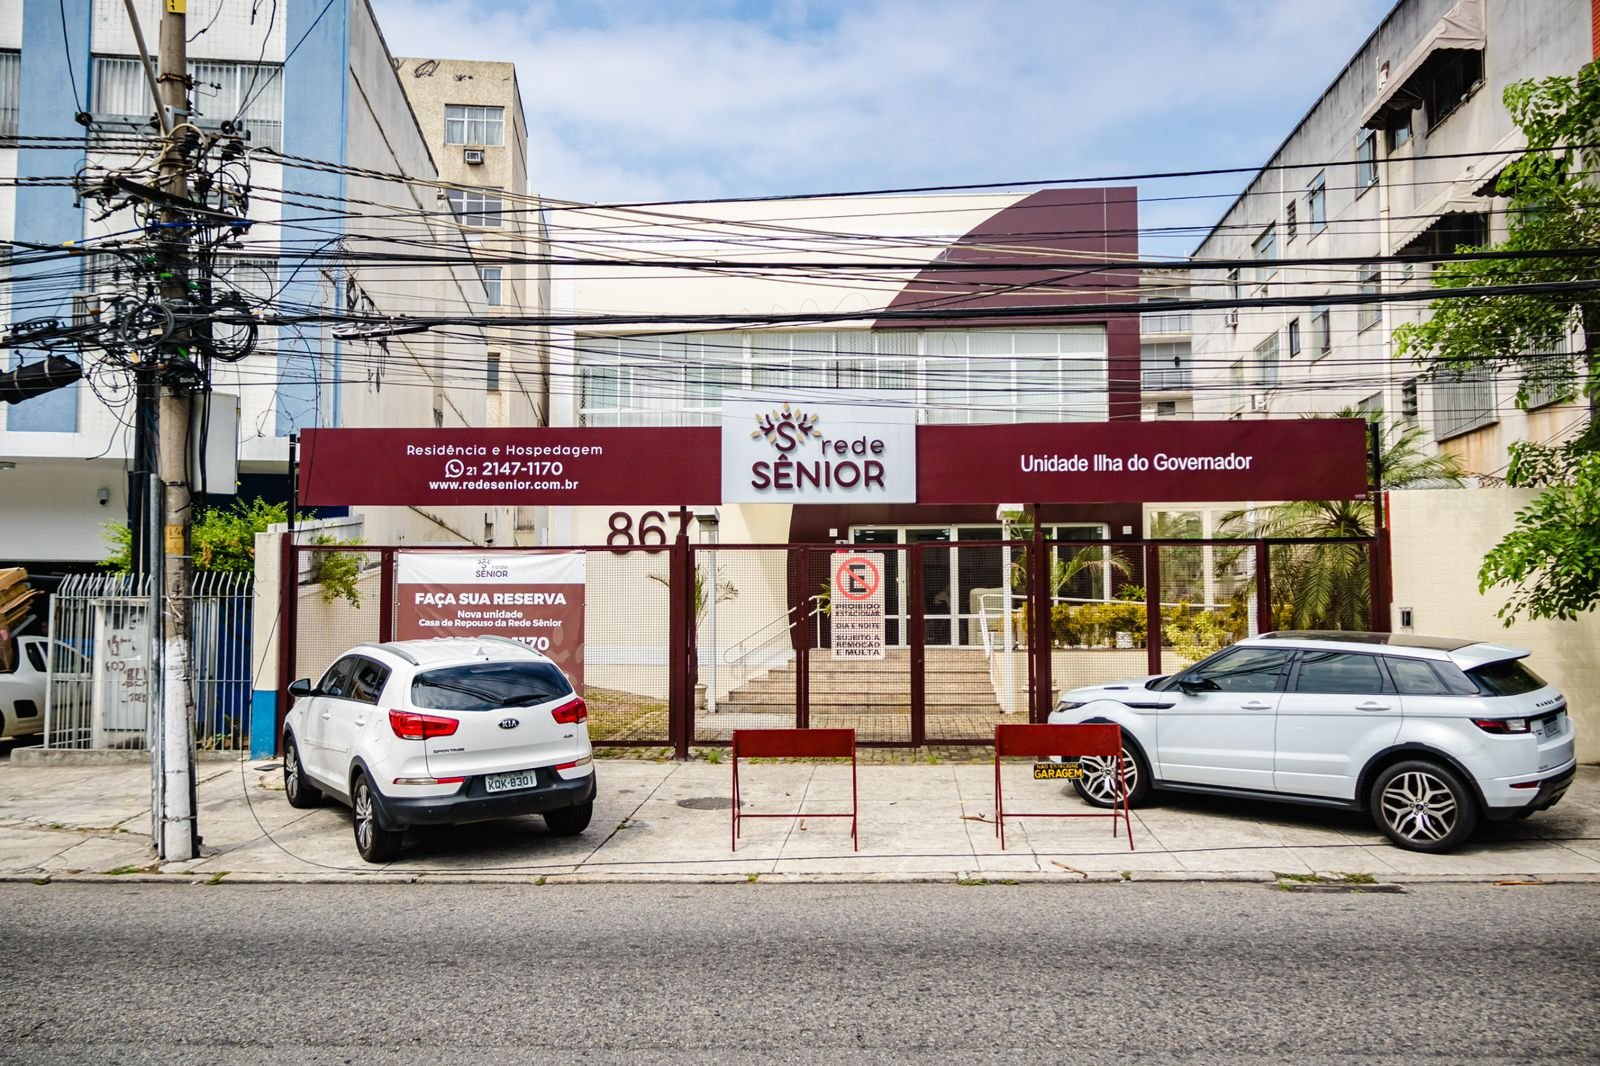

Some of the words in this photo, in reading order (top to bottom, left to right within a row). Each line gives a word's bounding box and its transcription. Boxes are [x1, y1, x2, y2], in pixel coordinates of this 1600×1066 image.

[407, 444, 487, 456] Residência
[492, 447, 500, 455] e
[506, 444, 603, 457] Hospedagem
[821, 435, 885, 455] rede
[1020, 454, 1089, 472] Unidade
[1094, 454, 1123, 471] Ilha
[1128, 453, 1149, 471] do
[1153, 453, 1253, 471] Governador
[466, 467, 477, 476] 21
[482, 462, 563, 476] 2147-1170
[751, 453, 885, 490] SÊNIOR
[429, 479, 579, 490] www.redesenior.com.br
[415, 593, 457, 608] FAÇA
[459, 592, 492, 605] SUA
[493, 592, 567, 605] RESERVA
[457, 610, 482, 619] Nova
[483, 609, 523, 619] unidade
[419, 619, 440, 627] Casa
[442, 618, 453, 627] de
[455, 619, 494, 628] Repouso
[495, 618, 507, 627] da
[508, 618, 532, 627] Rede
[533, 618, 562, 627] Sênior
[845, 648, 881, 656] MULTA
[502, 719, 517, 728] KIA
[1034, 768, 1083, 779] GARAGEM
